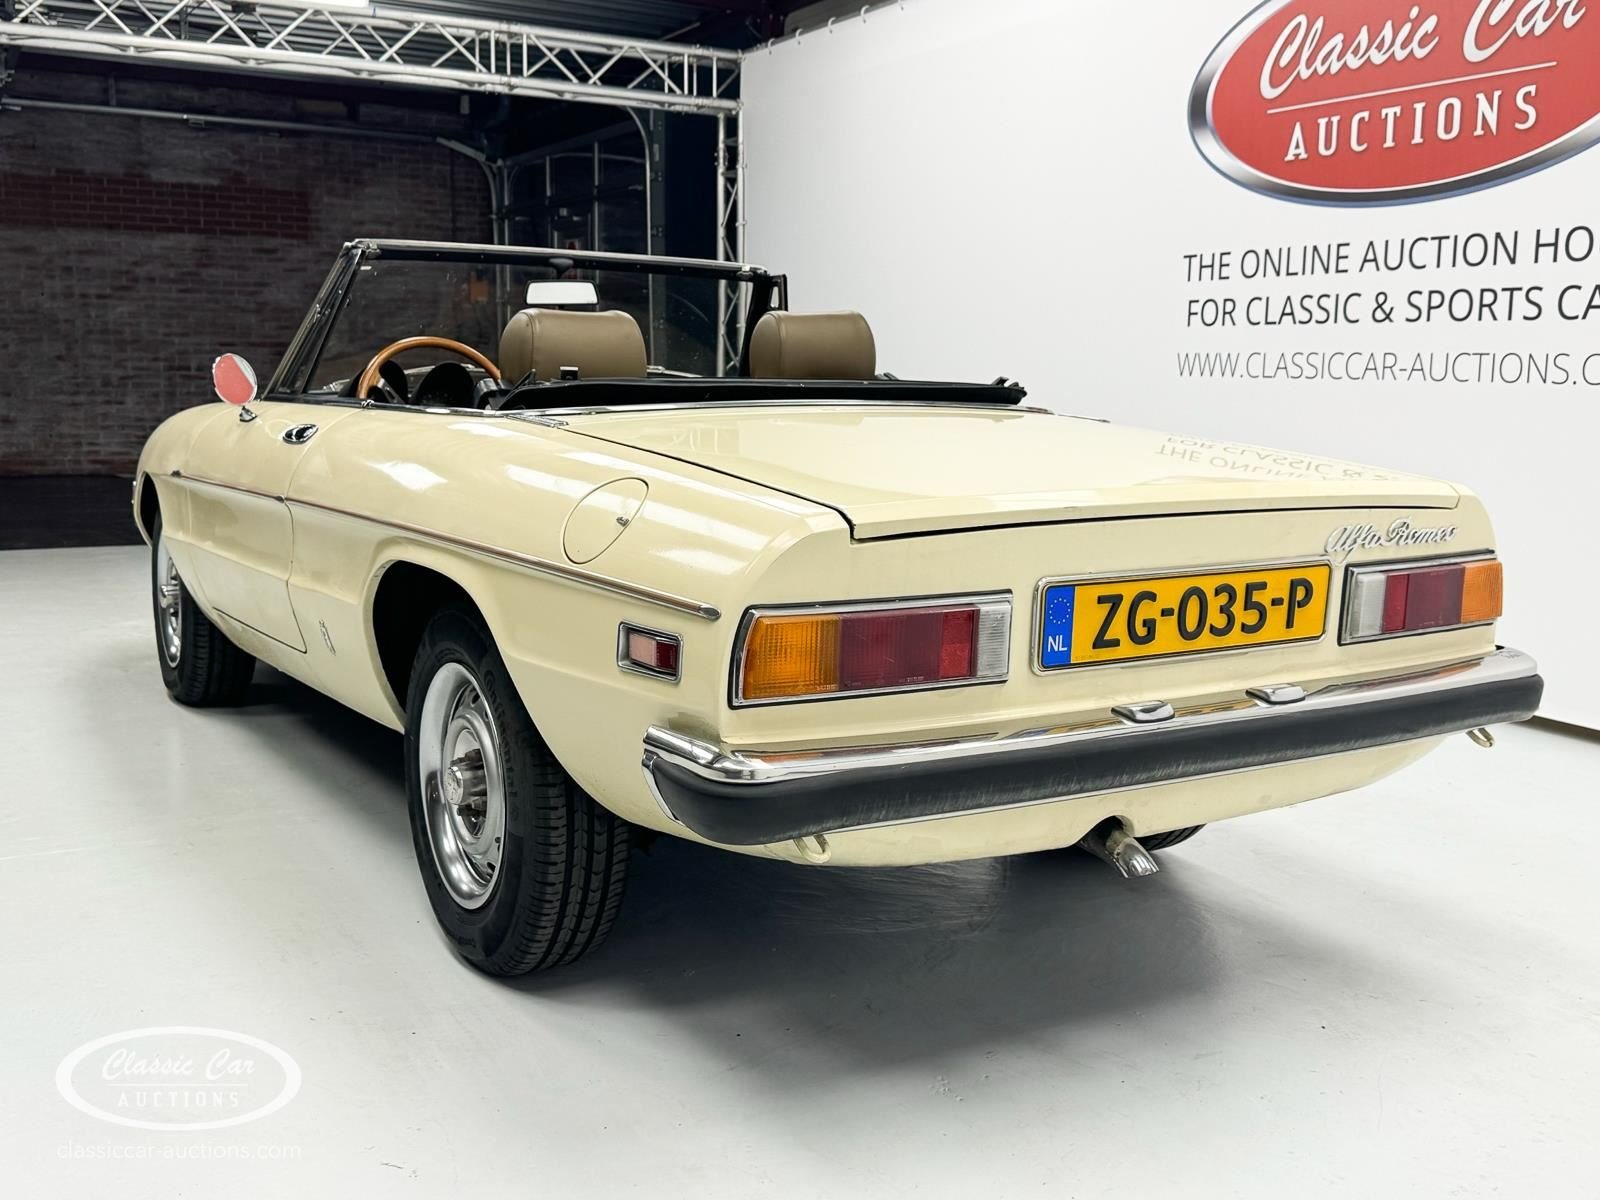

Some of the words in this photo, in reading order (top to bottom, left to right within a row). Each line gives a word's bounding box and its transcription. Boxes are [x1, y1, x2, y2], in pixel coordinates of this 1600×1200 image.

[1259, 6, 1439, 99] Classic
[1463, 0, 1586, 63] Car
[1284, 84, 1537, 162] AUCTIONS
[1183, 252, 1232, 282] THE
[1240, 243, 1350, 279] ONLINE
[1360, 230, 1519, 273] AUCTION
[1533, 226, 1600, 265] HO
[1187, 298, 1236, 327] FOR
[1245, 293, 1361, 326] CLASSIC
[1371, 291, 1395, 323] &
[1405, 286, 1543, 323] SPORTS
[1324, 523, 1382, 565] Alfa
[1383, 516, 1457, 546] Romeo
[1091, 577, 1314, 651] ZG-035-P
[1047, 634, 1068, 653] NL
